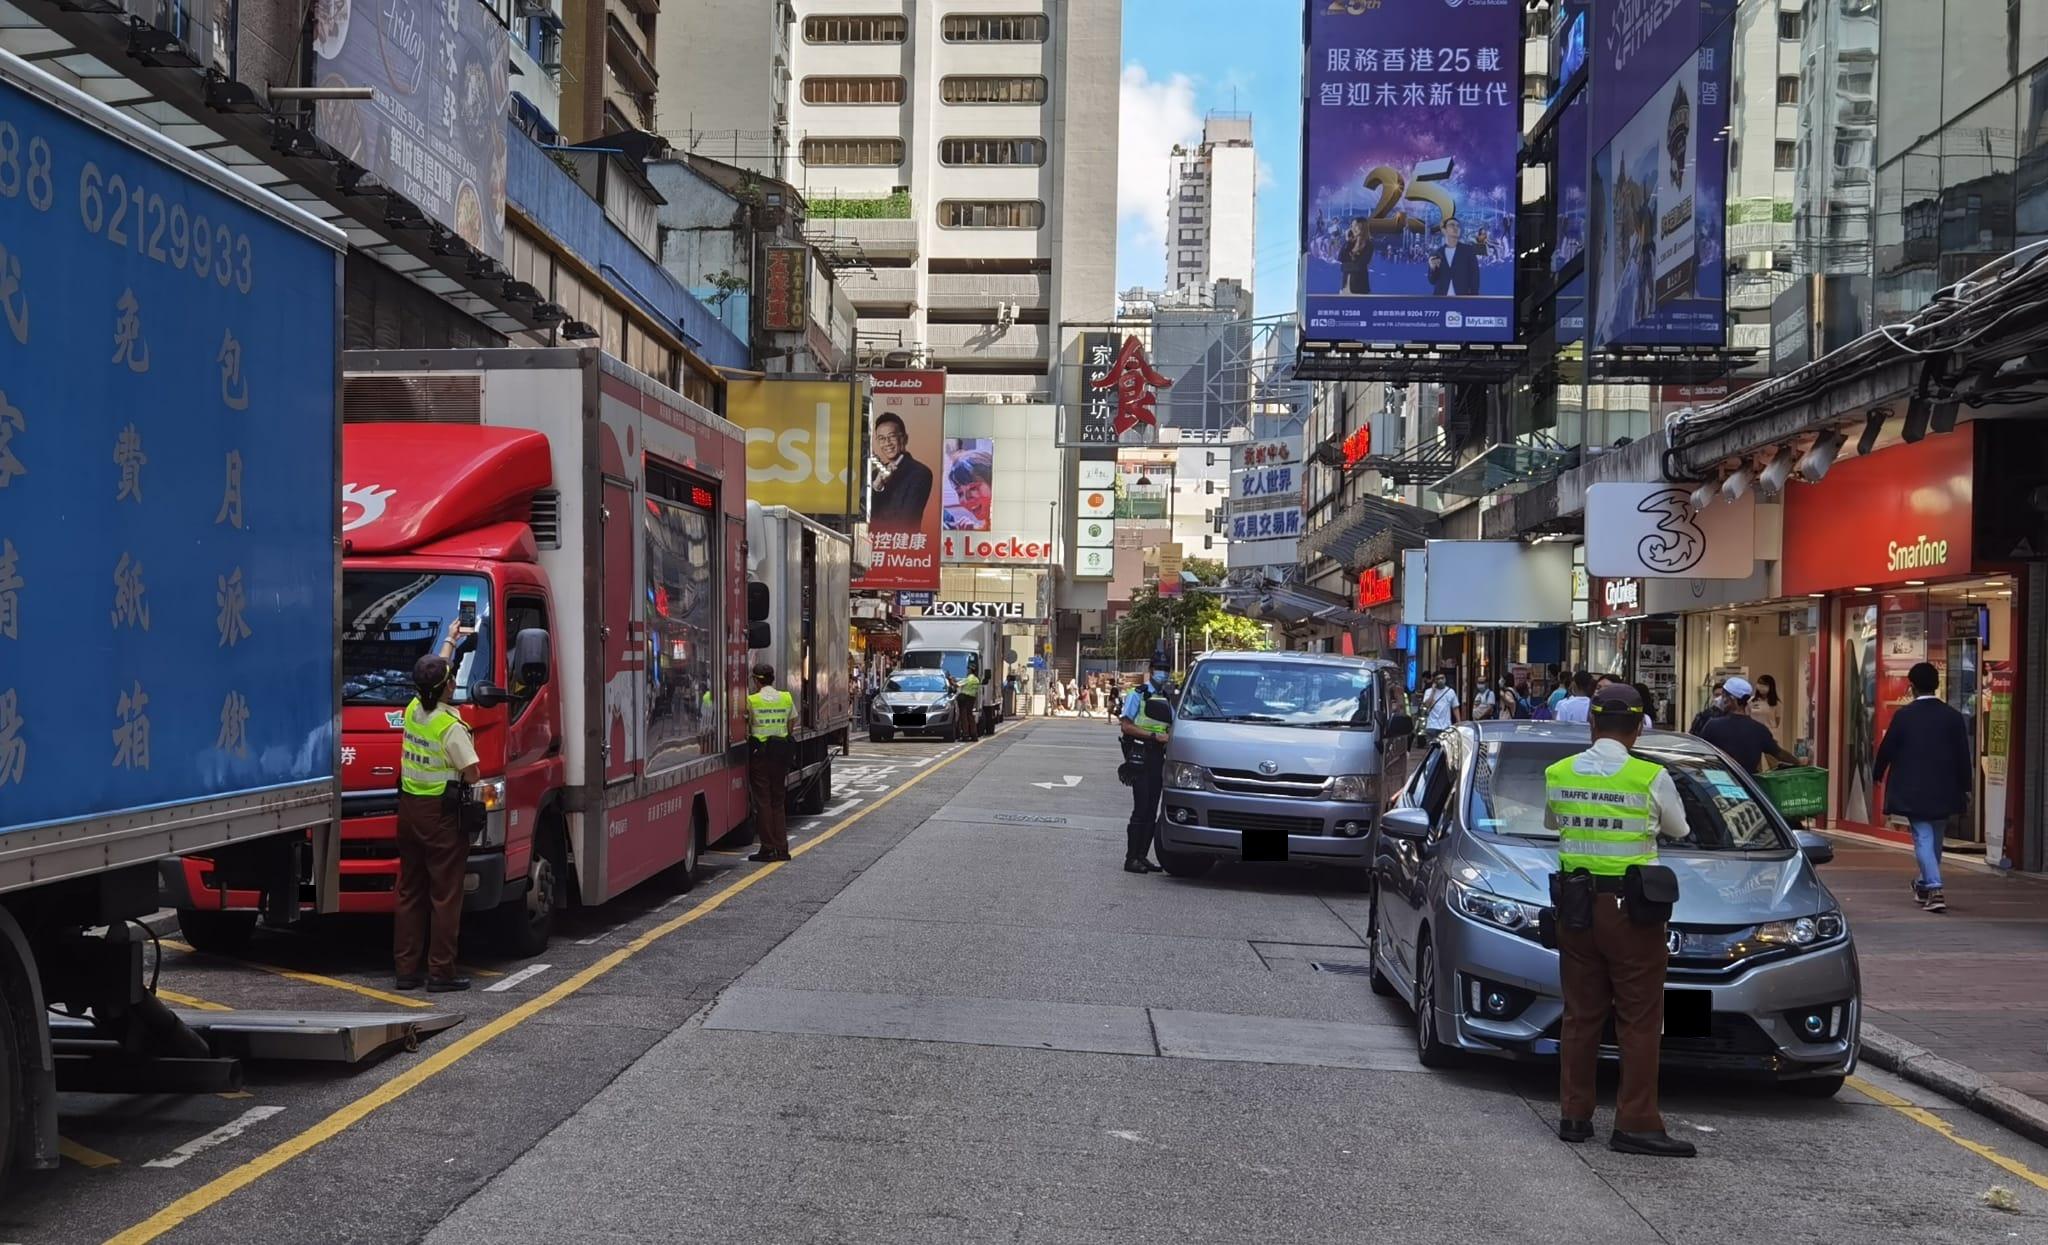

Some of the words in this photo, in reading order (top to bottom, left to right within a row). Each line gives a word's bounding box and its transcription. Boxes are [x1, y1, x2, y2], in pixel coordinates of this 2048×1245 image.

[1327, 47, 1504, 73] 服務香港25載
[1319, 81, 1510, 107] 智迎未來新世代
[1362, 156, 1456, 235] 25
[80, 161, 252, 295] 62129933
[1242, 468, 1292, 497] 女人世界
[964, 536, 1052, 559] Locker
[1887, 534, 1949, 573] SmarTone
[887, 554, 931, 568] iWand
[972, 602, 1022, 617] STYLE
[1561, 790, 1589, 800] TRAFFIC
[1592, 792, 1624, 803] WARDEN
